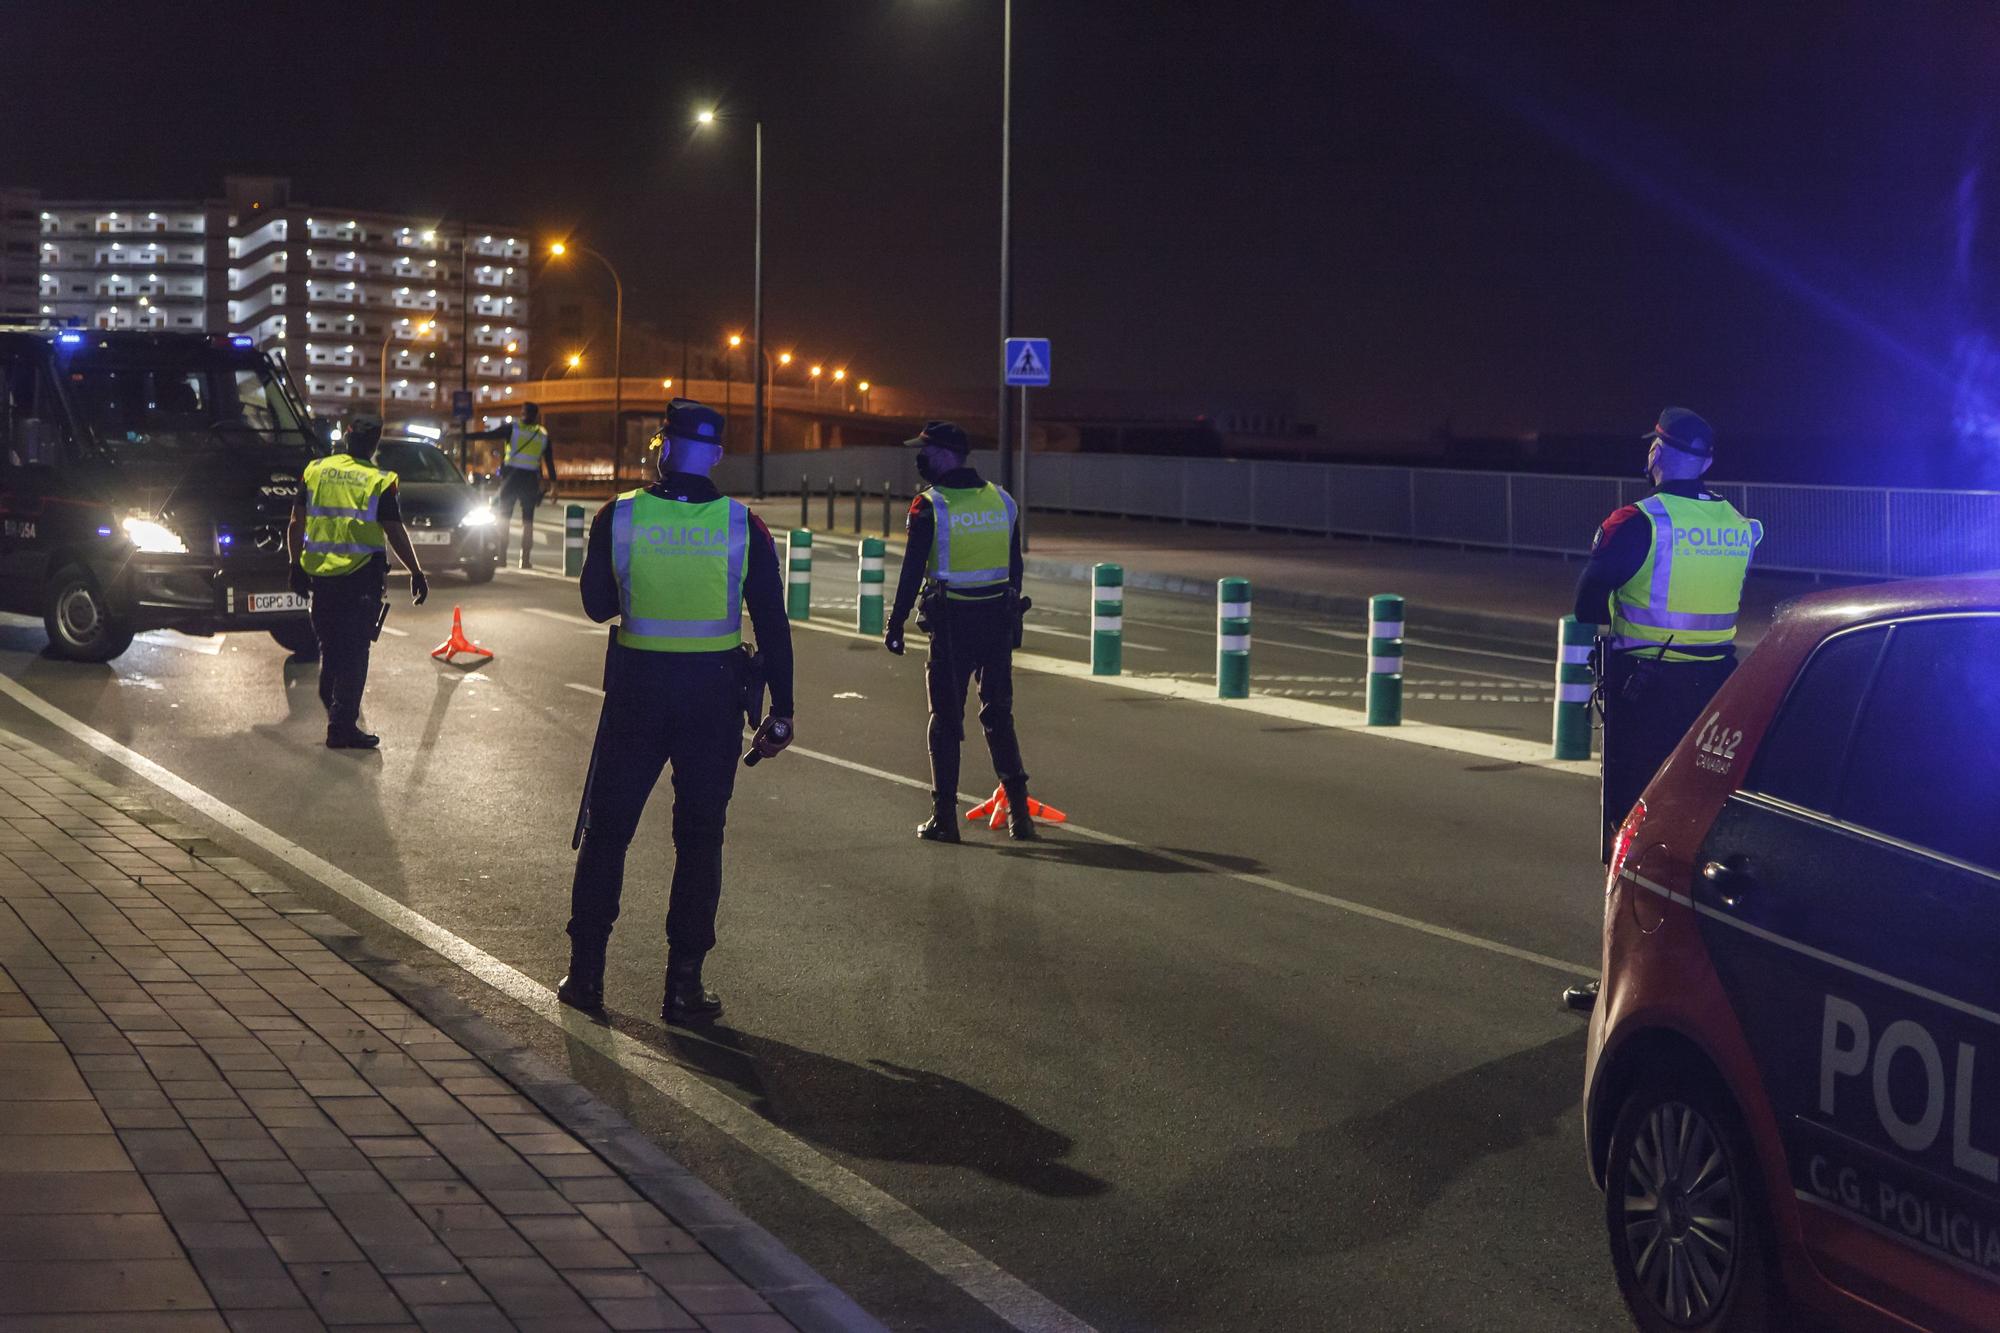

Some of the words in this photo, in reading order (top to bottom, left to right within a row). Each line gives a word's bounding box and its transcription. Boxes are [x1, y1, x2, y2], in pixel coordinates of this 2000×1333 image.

[631, 525, 728, 546] POLICIA
[1674, 527, 1749, 548] POLICIA
[286, 595, 293, 607] 3
